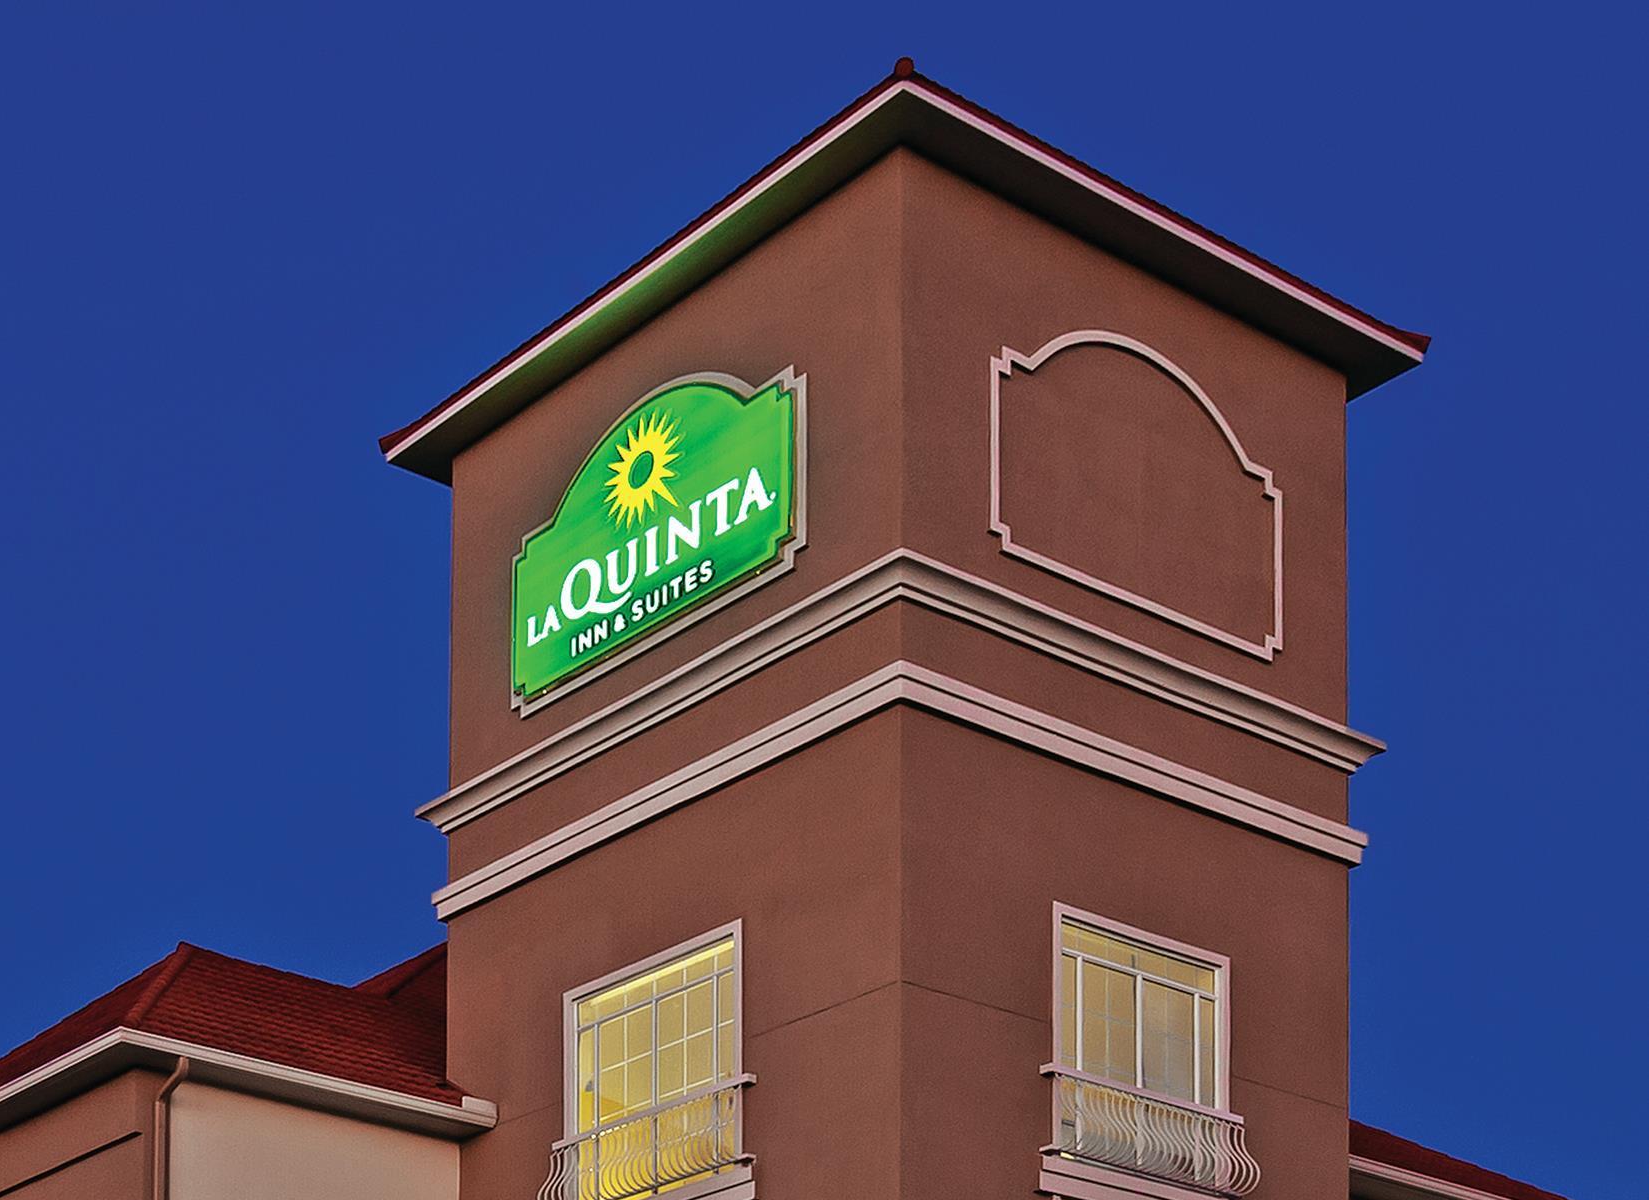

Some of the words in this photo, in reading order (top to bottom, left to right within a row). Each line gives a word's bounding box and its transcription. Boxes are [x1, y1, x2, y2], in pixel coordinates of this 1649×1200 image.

[527, 604, 561, 647] LA
[560, 467, 775, 619] QUINTA
[570, 622, 608, 657] INN
[614, 614, 627, 633] &
[631, 560, 713, 622] SUITES
